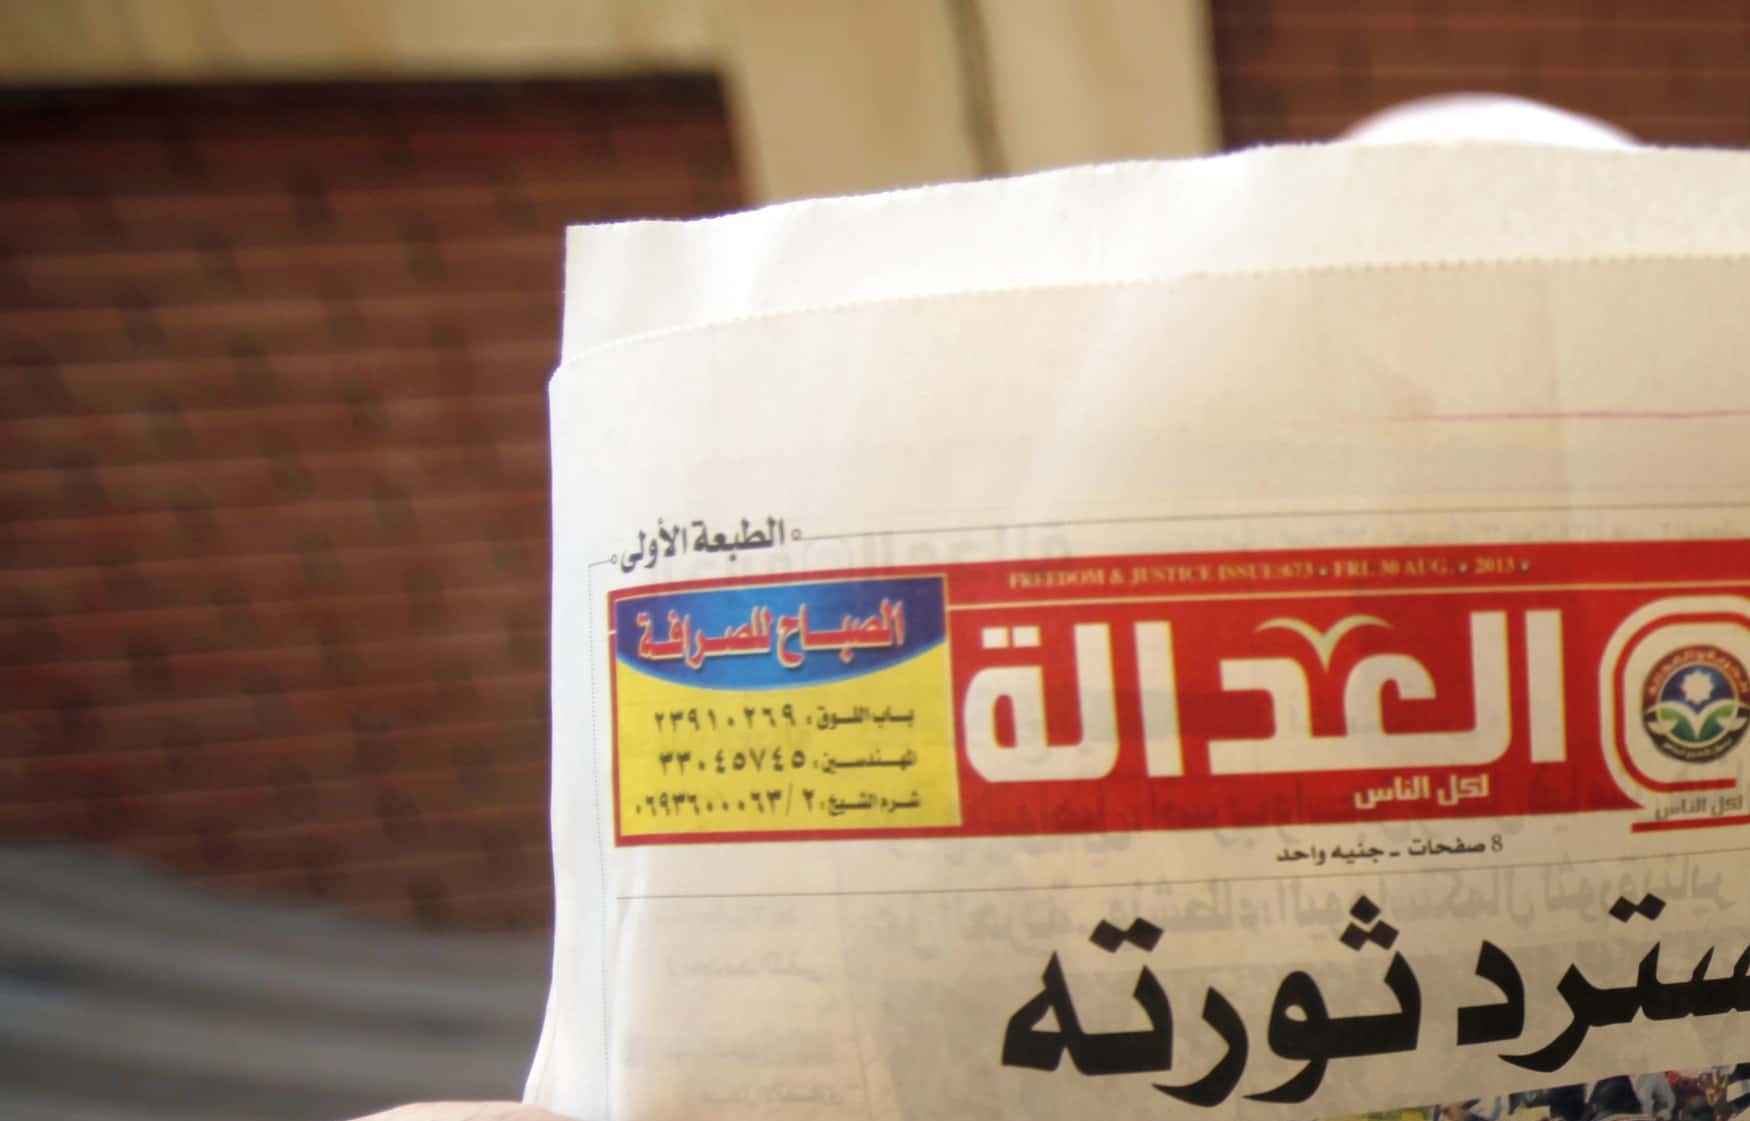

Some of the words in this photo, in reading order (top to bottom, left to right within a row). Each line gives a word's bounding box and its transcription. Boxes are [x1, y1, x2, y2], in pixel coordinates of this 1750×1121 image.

[619, 518, 689, 573] الأولى
[693, 517, 786, 555] الطبعة
[634, 605, 773, 672] للصرافة
[778, 599, 906, 671] الصباح
[963, 609, 1567, 783] العدالة
[659, 746, 807, 777] ٣٣٠٤٥٧٤٥
[1354, 776, 1431, 811] الناس
[1437, 774, 1491, 807] لكل
[1275, 842, 1328, 867] واحد
[1330, 841, 1385, 866] جنيه
[1406, 834, 1487, 859] صفحات
[1489, 833, 1504, 853] 8
[1001, 895, 1421, 1108] ثورته
